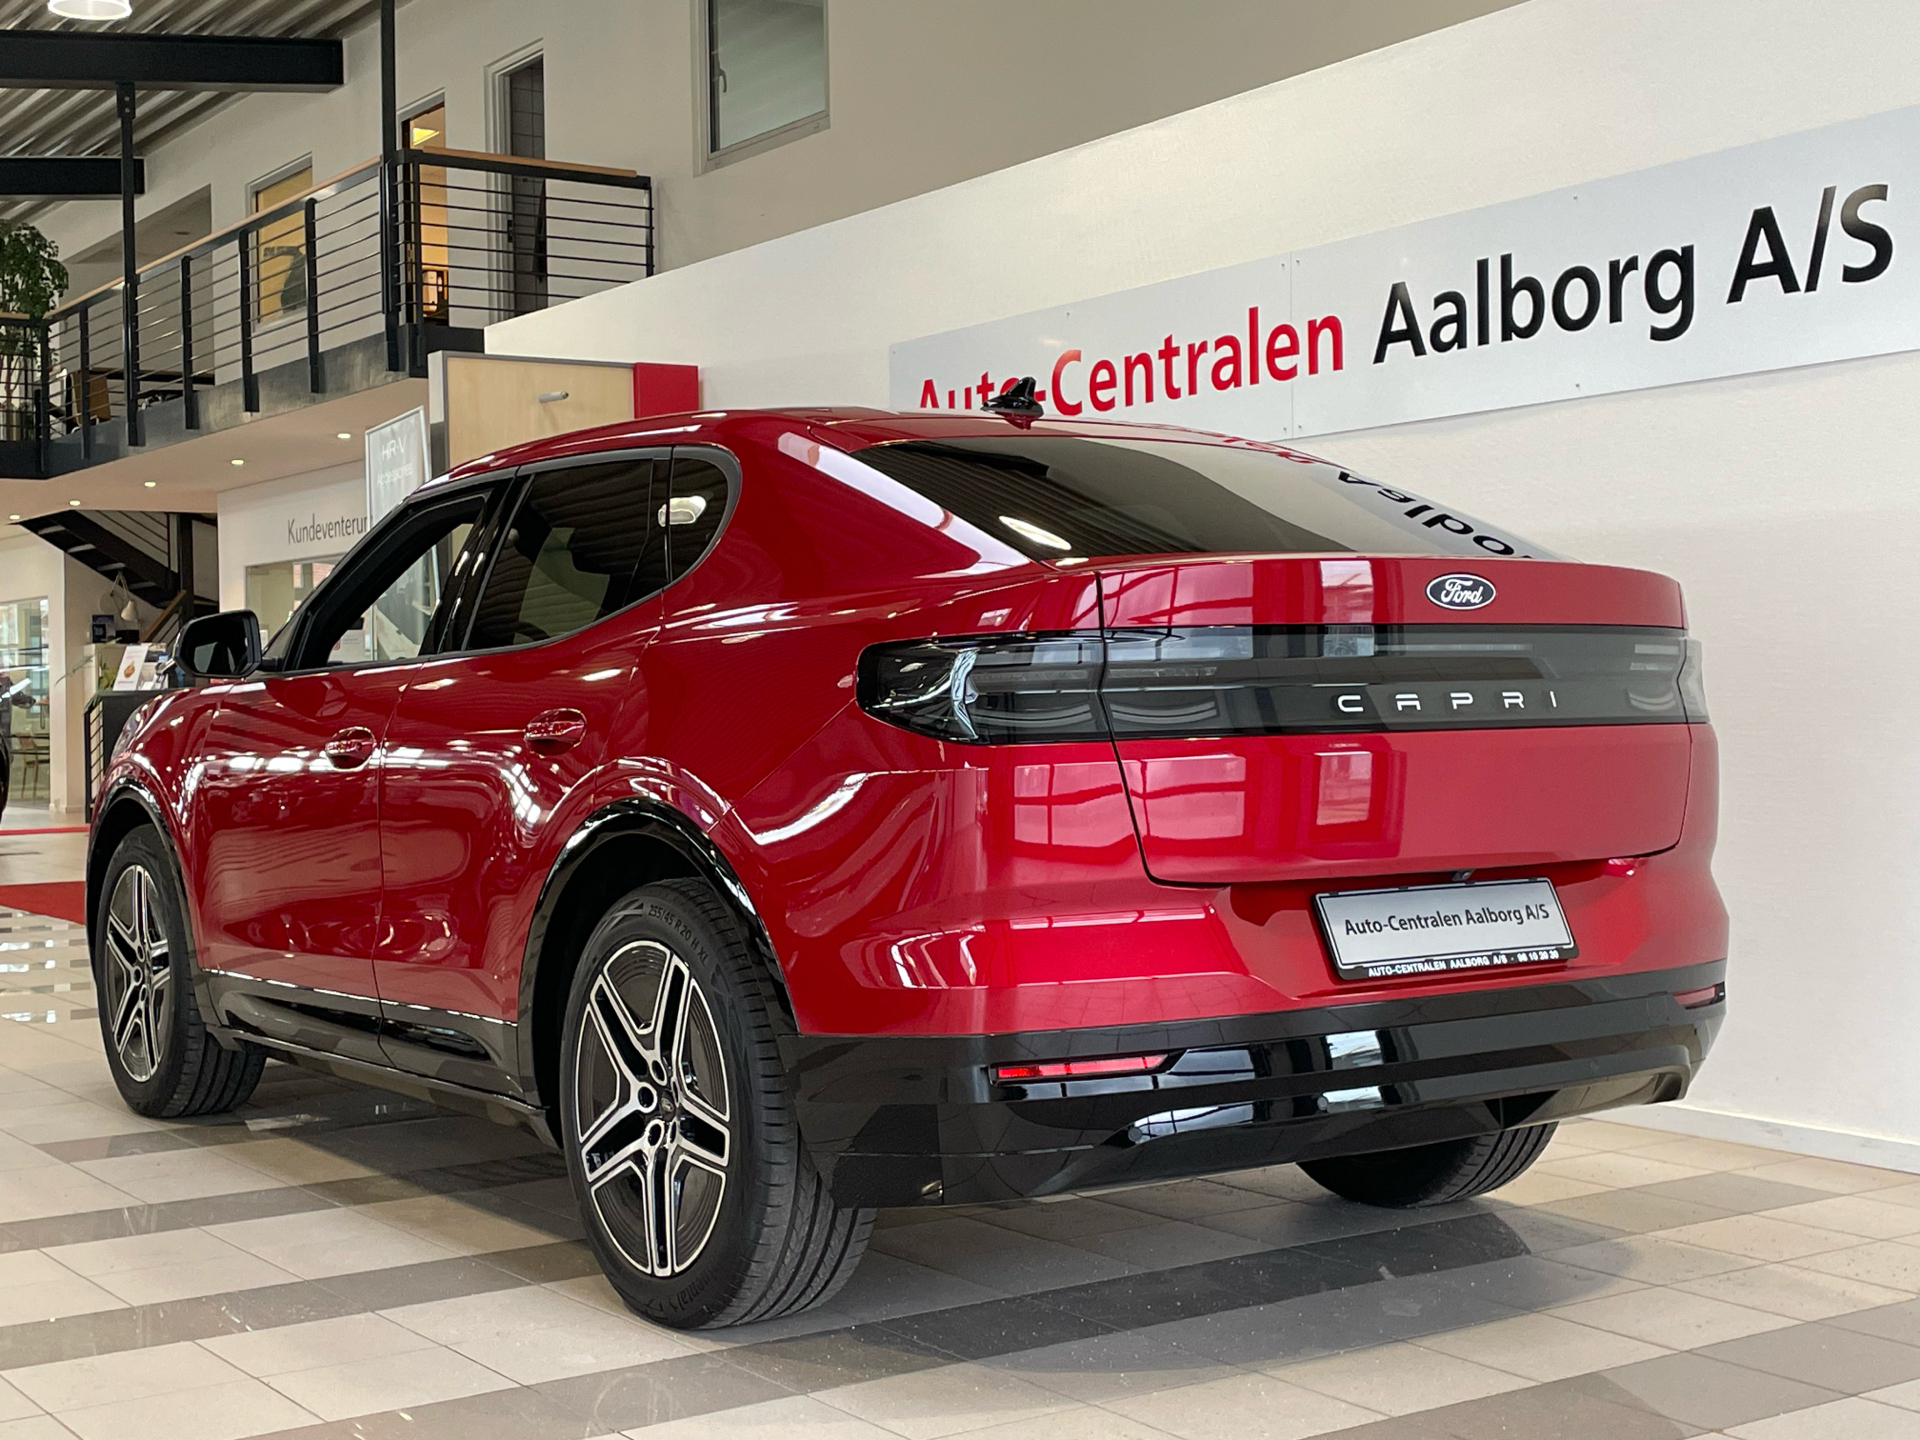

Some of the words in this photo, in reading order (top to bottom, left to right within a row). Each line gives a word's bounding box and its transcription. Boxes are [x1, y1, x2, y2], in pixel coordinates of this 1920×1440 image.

[920, 306, 1344, 416] t-Centralen
[1373, 244, 1695, 364] Aalborg
[1726, 184, 1894, 304] A/S
[1440, 578, 1484, 604] Ford
[1337, 690, 1558, 713] CAPRI
[647, 904, 675, 926] 255/45
[674, 919, 683, 932] R
[680, 925, 692, 941] 20
[1344, 911, 1463, 935] Auto-Centralen
[1464, 907, 1524, 926] Aalborg
[1525, 903, 1550, 920] A/S
[1368, 960, 1447, 977] AUTO-CENTRALEN
[1449, 956, 1490, 969] AALBORG
[1493, 954, 1508, 965] A/S
